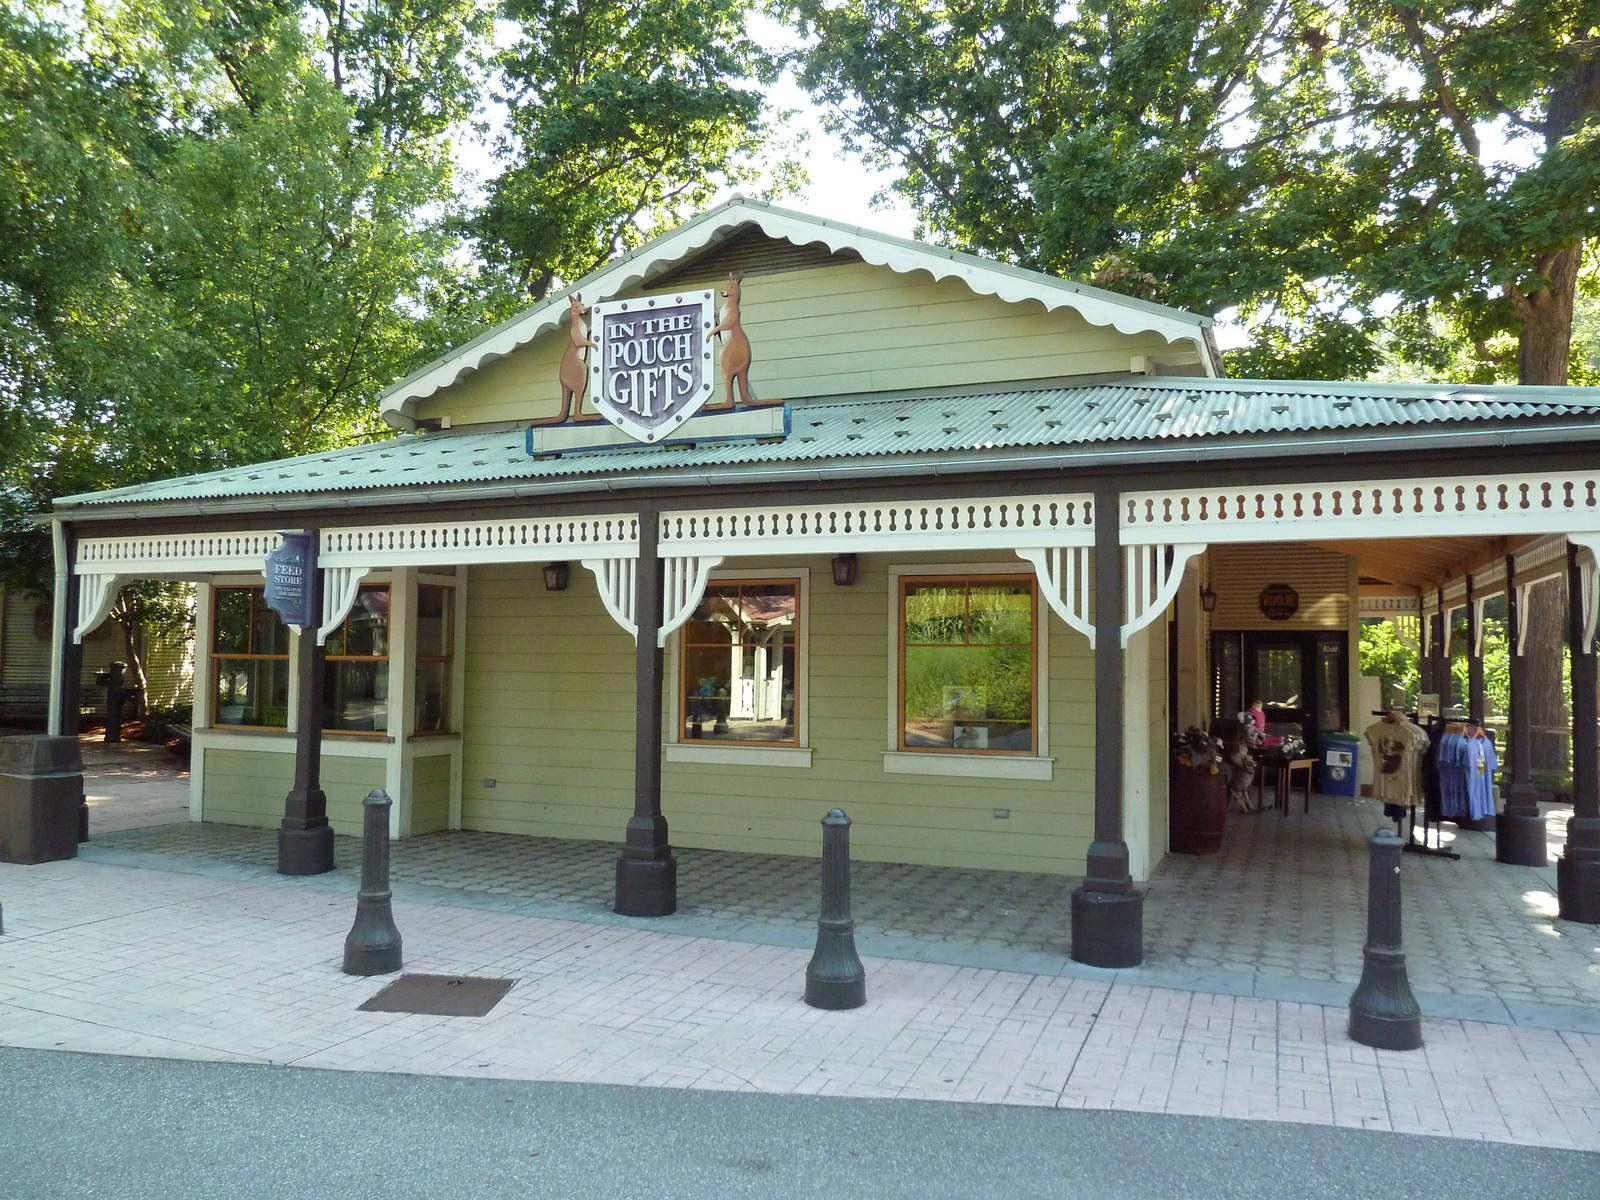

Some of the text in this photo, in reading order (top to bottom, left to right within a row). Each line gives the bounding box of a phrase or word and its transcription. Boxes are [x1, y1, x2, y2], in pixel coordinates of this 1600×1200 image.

[608, 314, 693, 340] IN THE
[608, 333, 693, 369] POUCH
[608, 363, 694, 418] GIFTS
[273, 575, 303, 585] STORE
[274, 564, 303, 576] FEED
